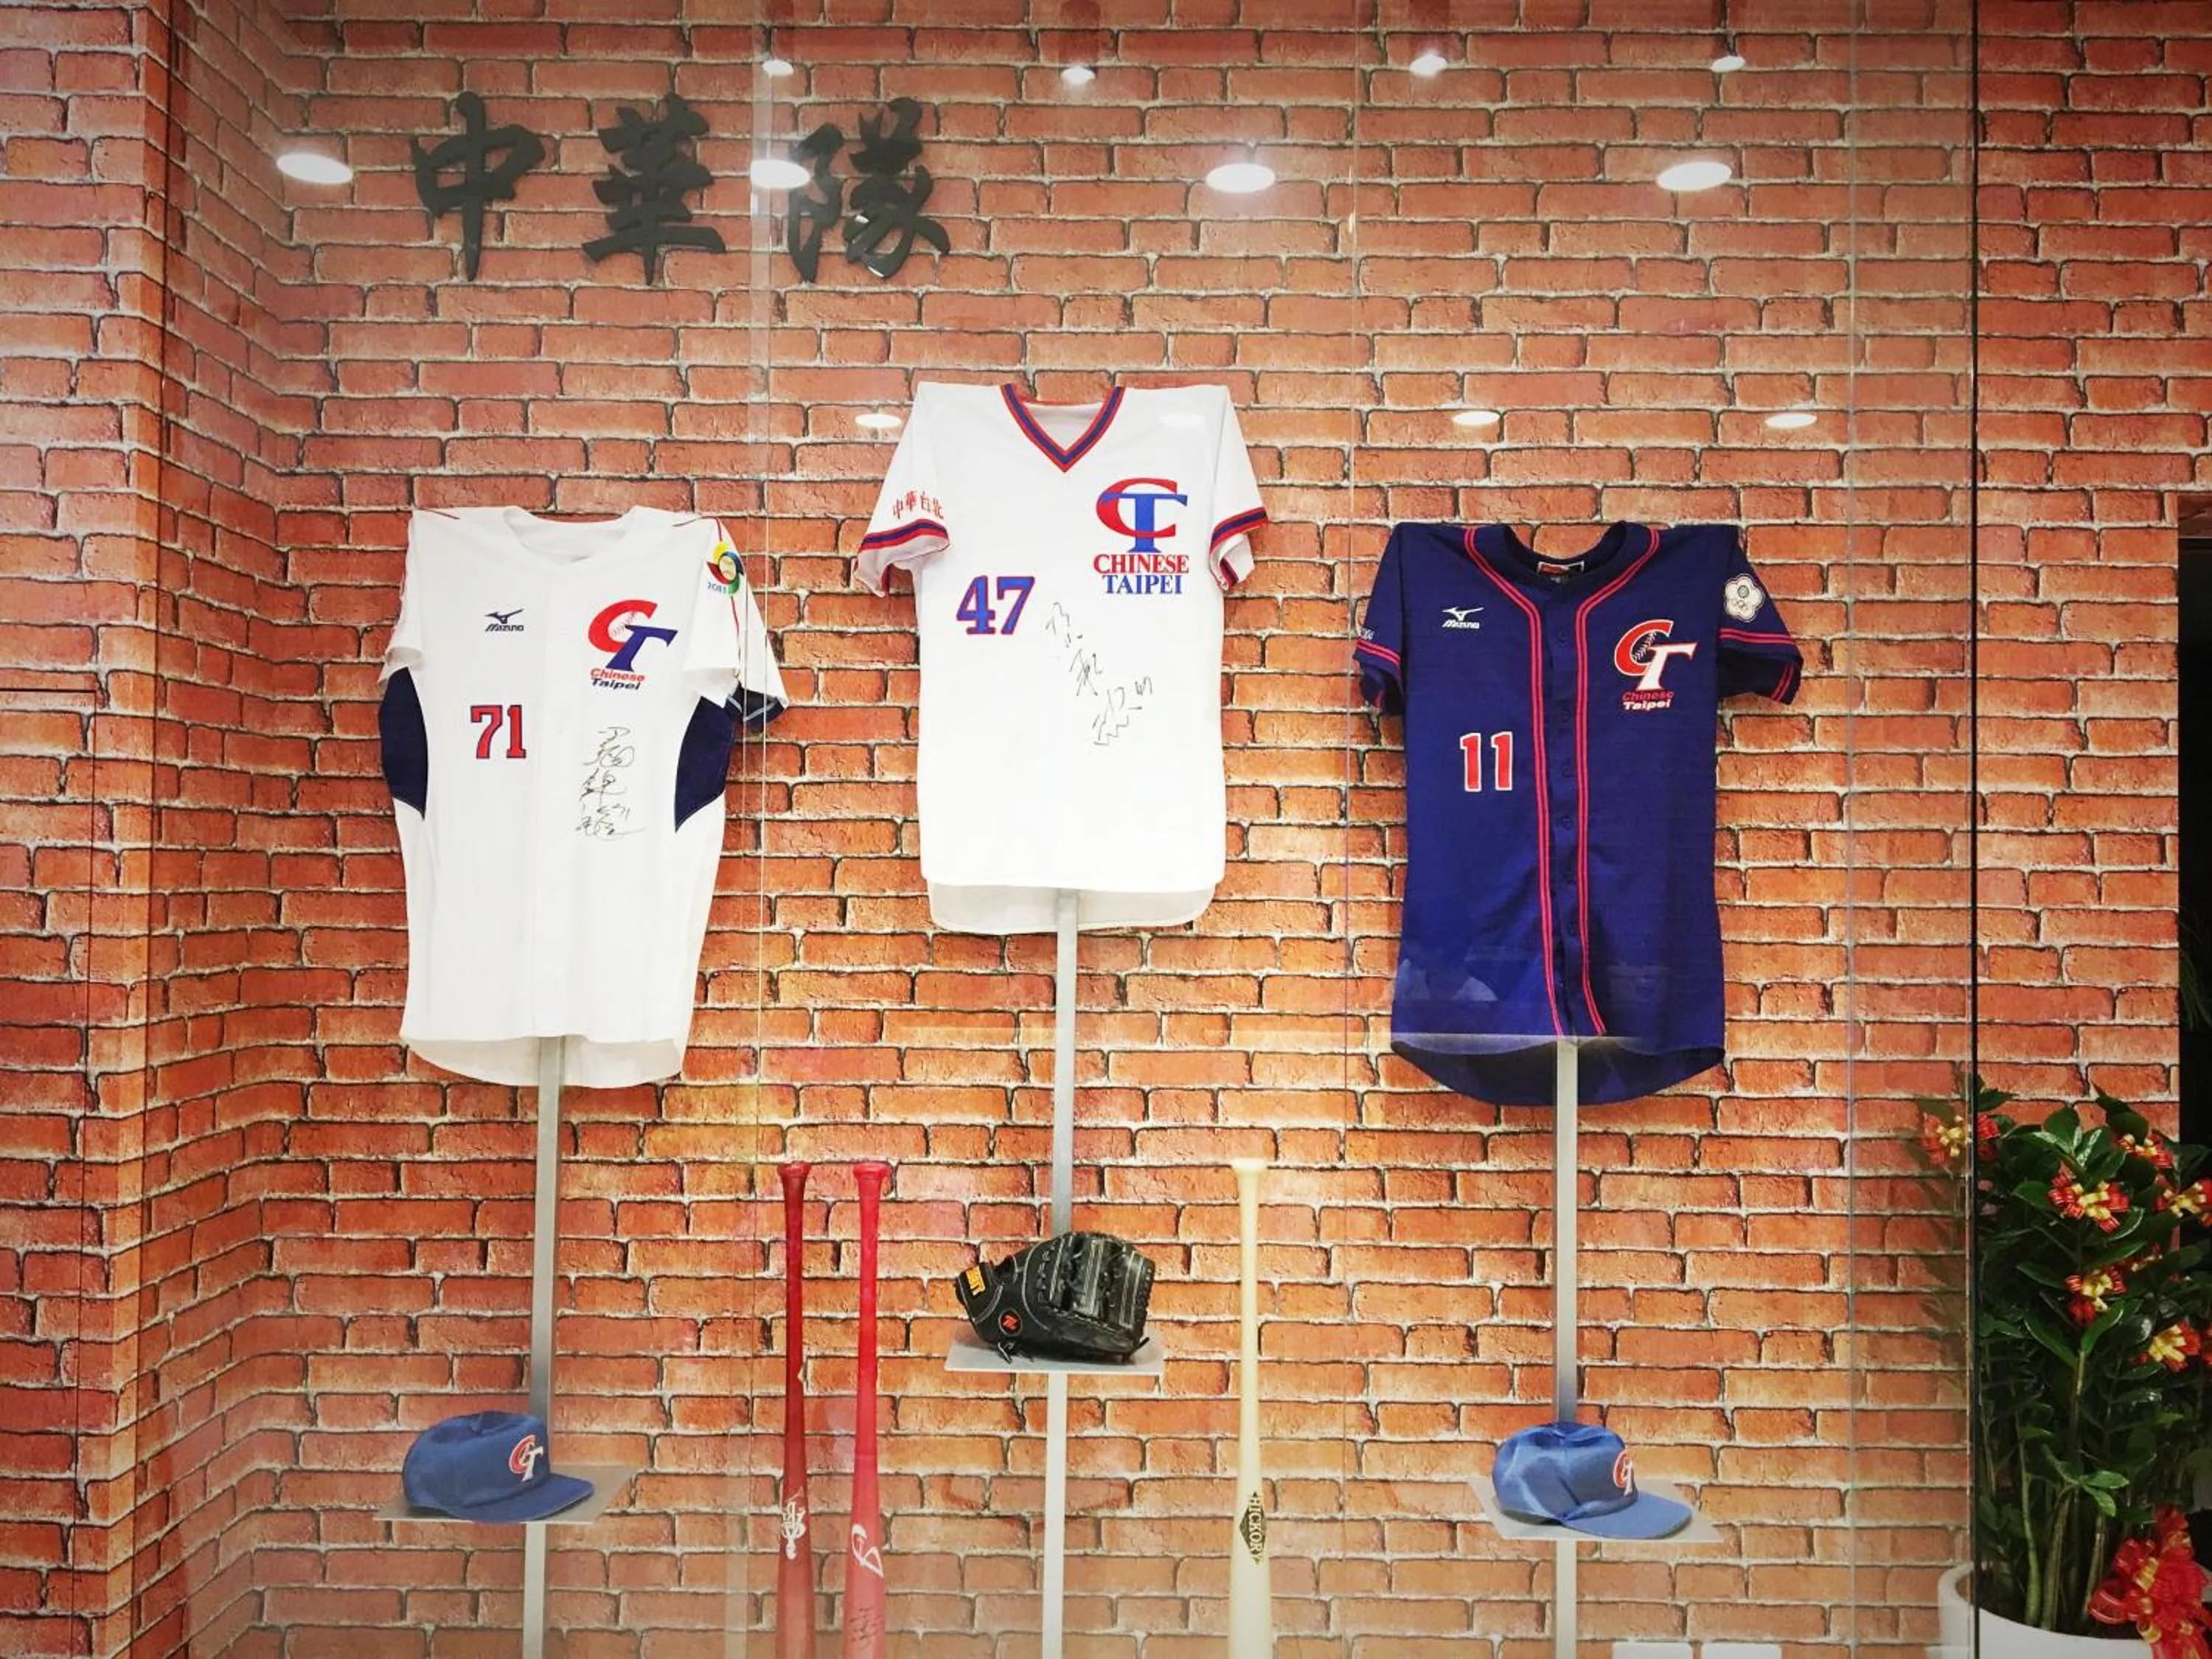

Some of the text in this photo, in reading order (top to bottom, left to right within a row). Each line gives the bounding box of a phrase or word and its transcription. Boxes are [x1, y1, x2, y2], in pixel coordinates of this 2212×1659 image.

[410, 91, 950, 285] 中華隊
[1093, 554, 1189, 574] CHINESE
[1102, 574, 1183, 594] TAIPEI
[956, 575, 1035, 635] 47
[590, 668, 645, 682] Chinese
[591, 678, 641, 690] Taipei
[1622, 691, 1674, 701] Chinese
[1624, 699, 1671, 710] Taipei
[470, 704, 527, 759] 71
[1460, 731, 1513, 792] 11
[1248, 1498, 1263, 1561] HICKORY
